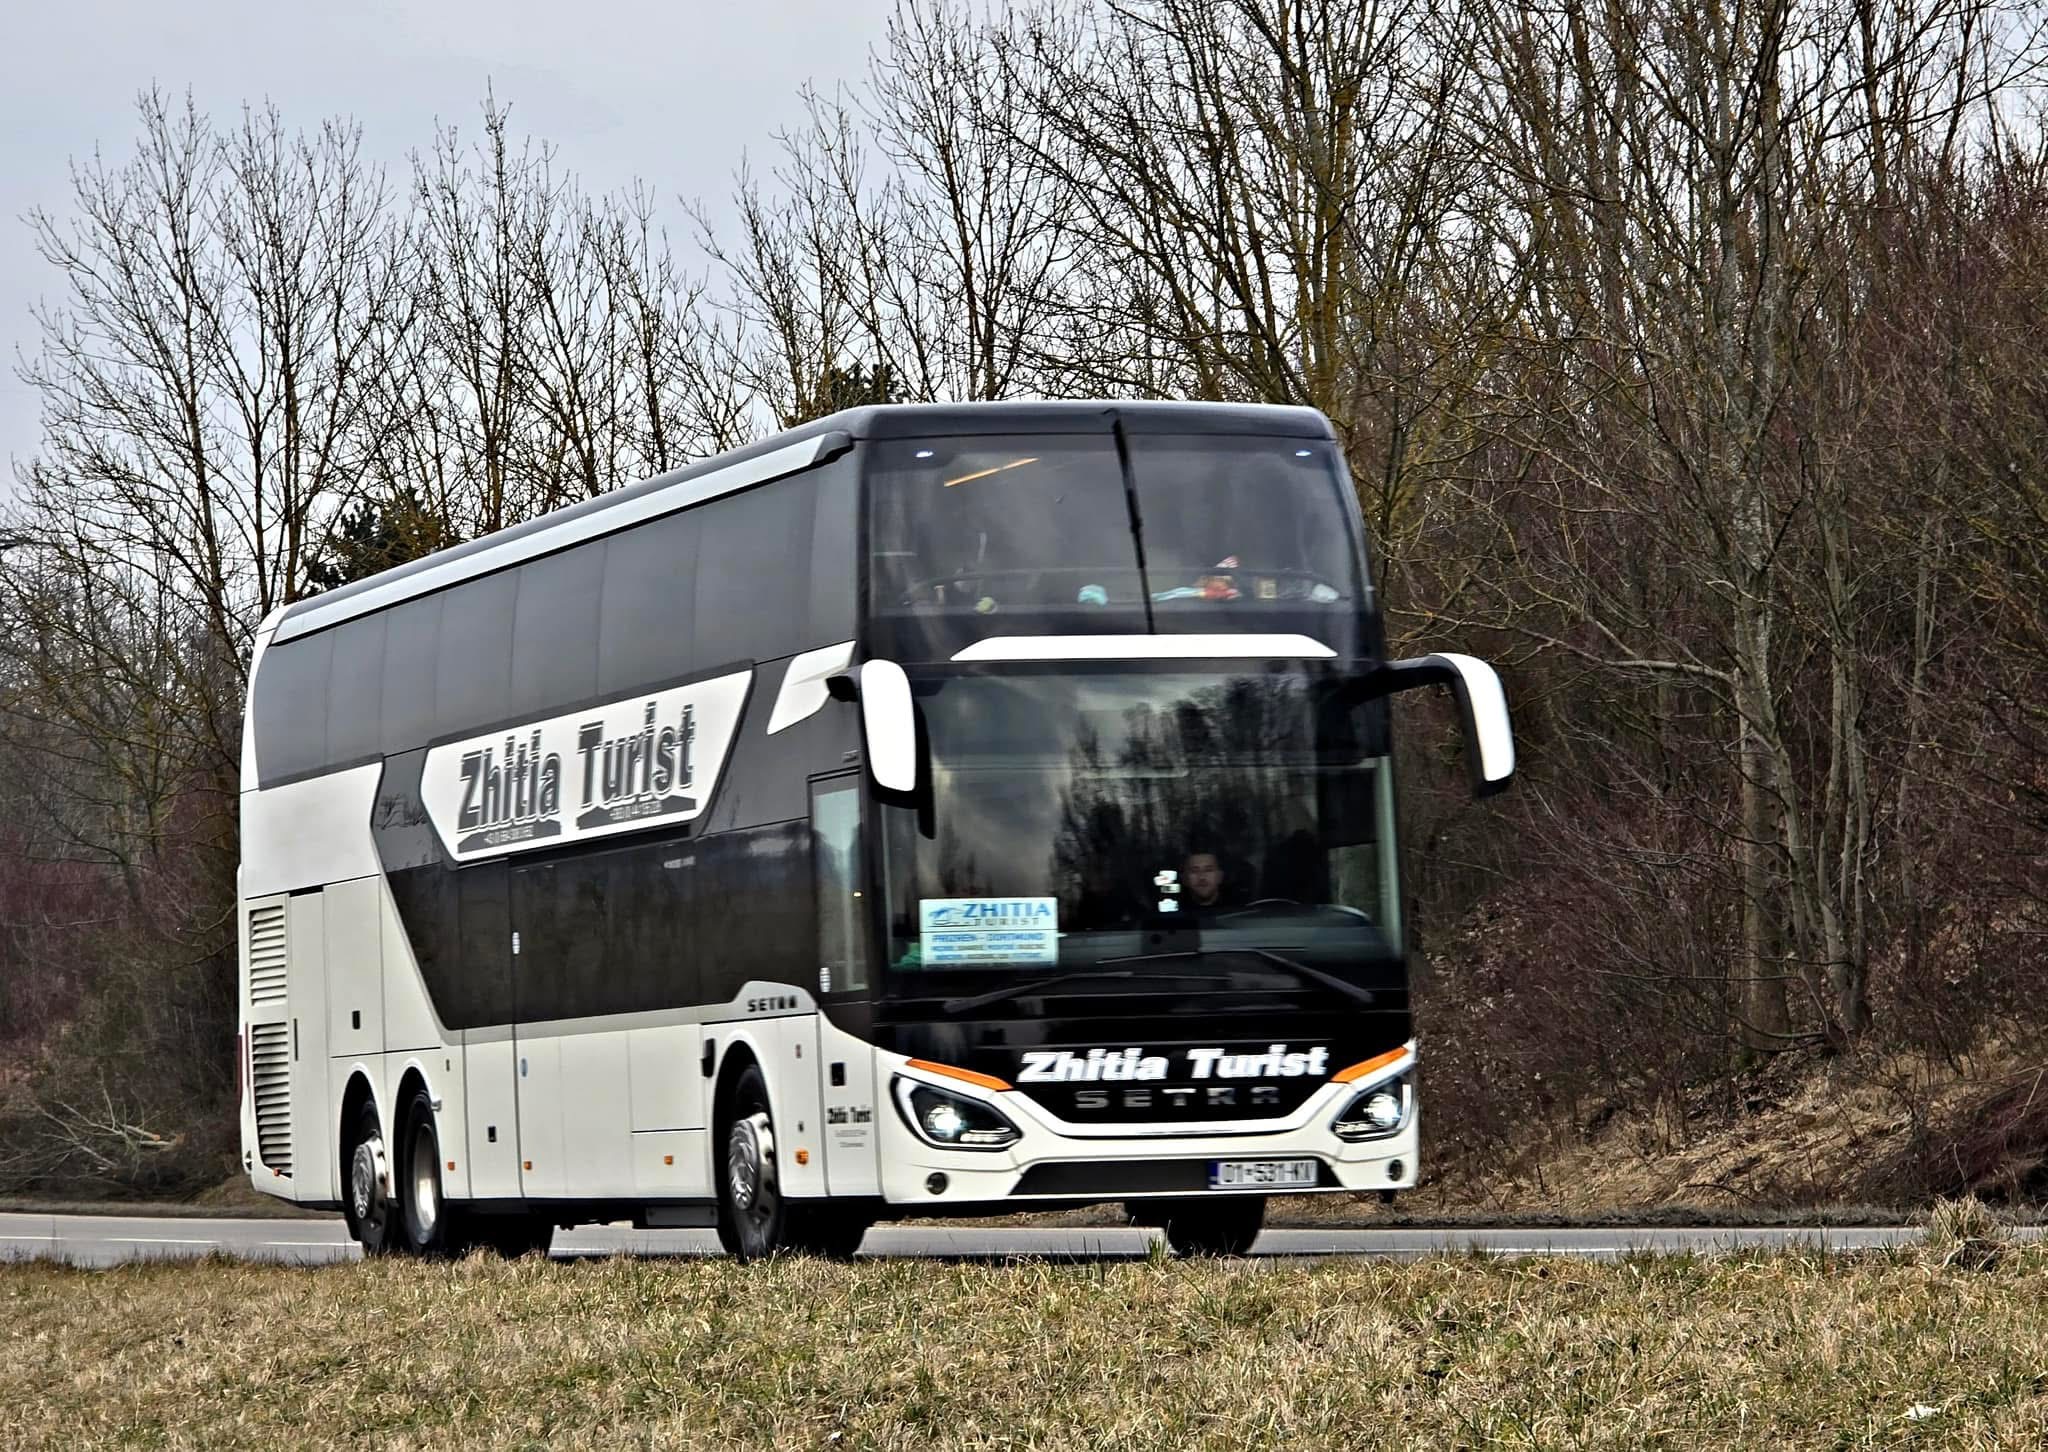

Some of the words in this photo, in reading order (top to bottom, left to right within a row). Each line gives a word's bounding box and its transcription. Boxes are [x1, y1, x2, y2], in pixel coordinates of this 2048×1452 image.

[457, 728, 562, 834] Zhitia
[577, 700, 695, 808] Turist
[964, 903, 1050, 918] ZHITIA
[974, 918, 1040, 926] TURIST
[1017, 1048, 1169, 1083] Zhitia
[1187, 1044, 1329, 1079] Turist
[1075, 1086, 1280, 1109] SETRA
